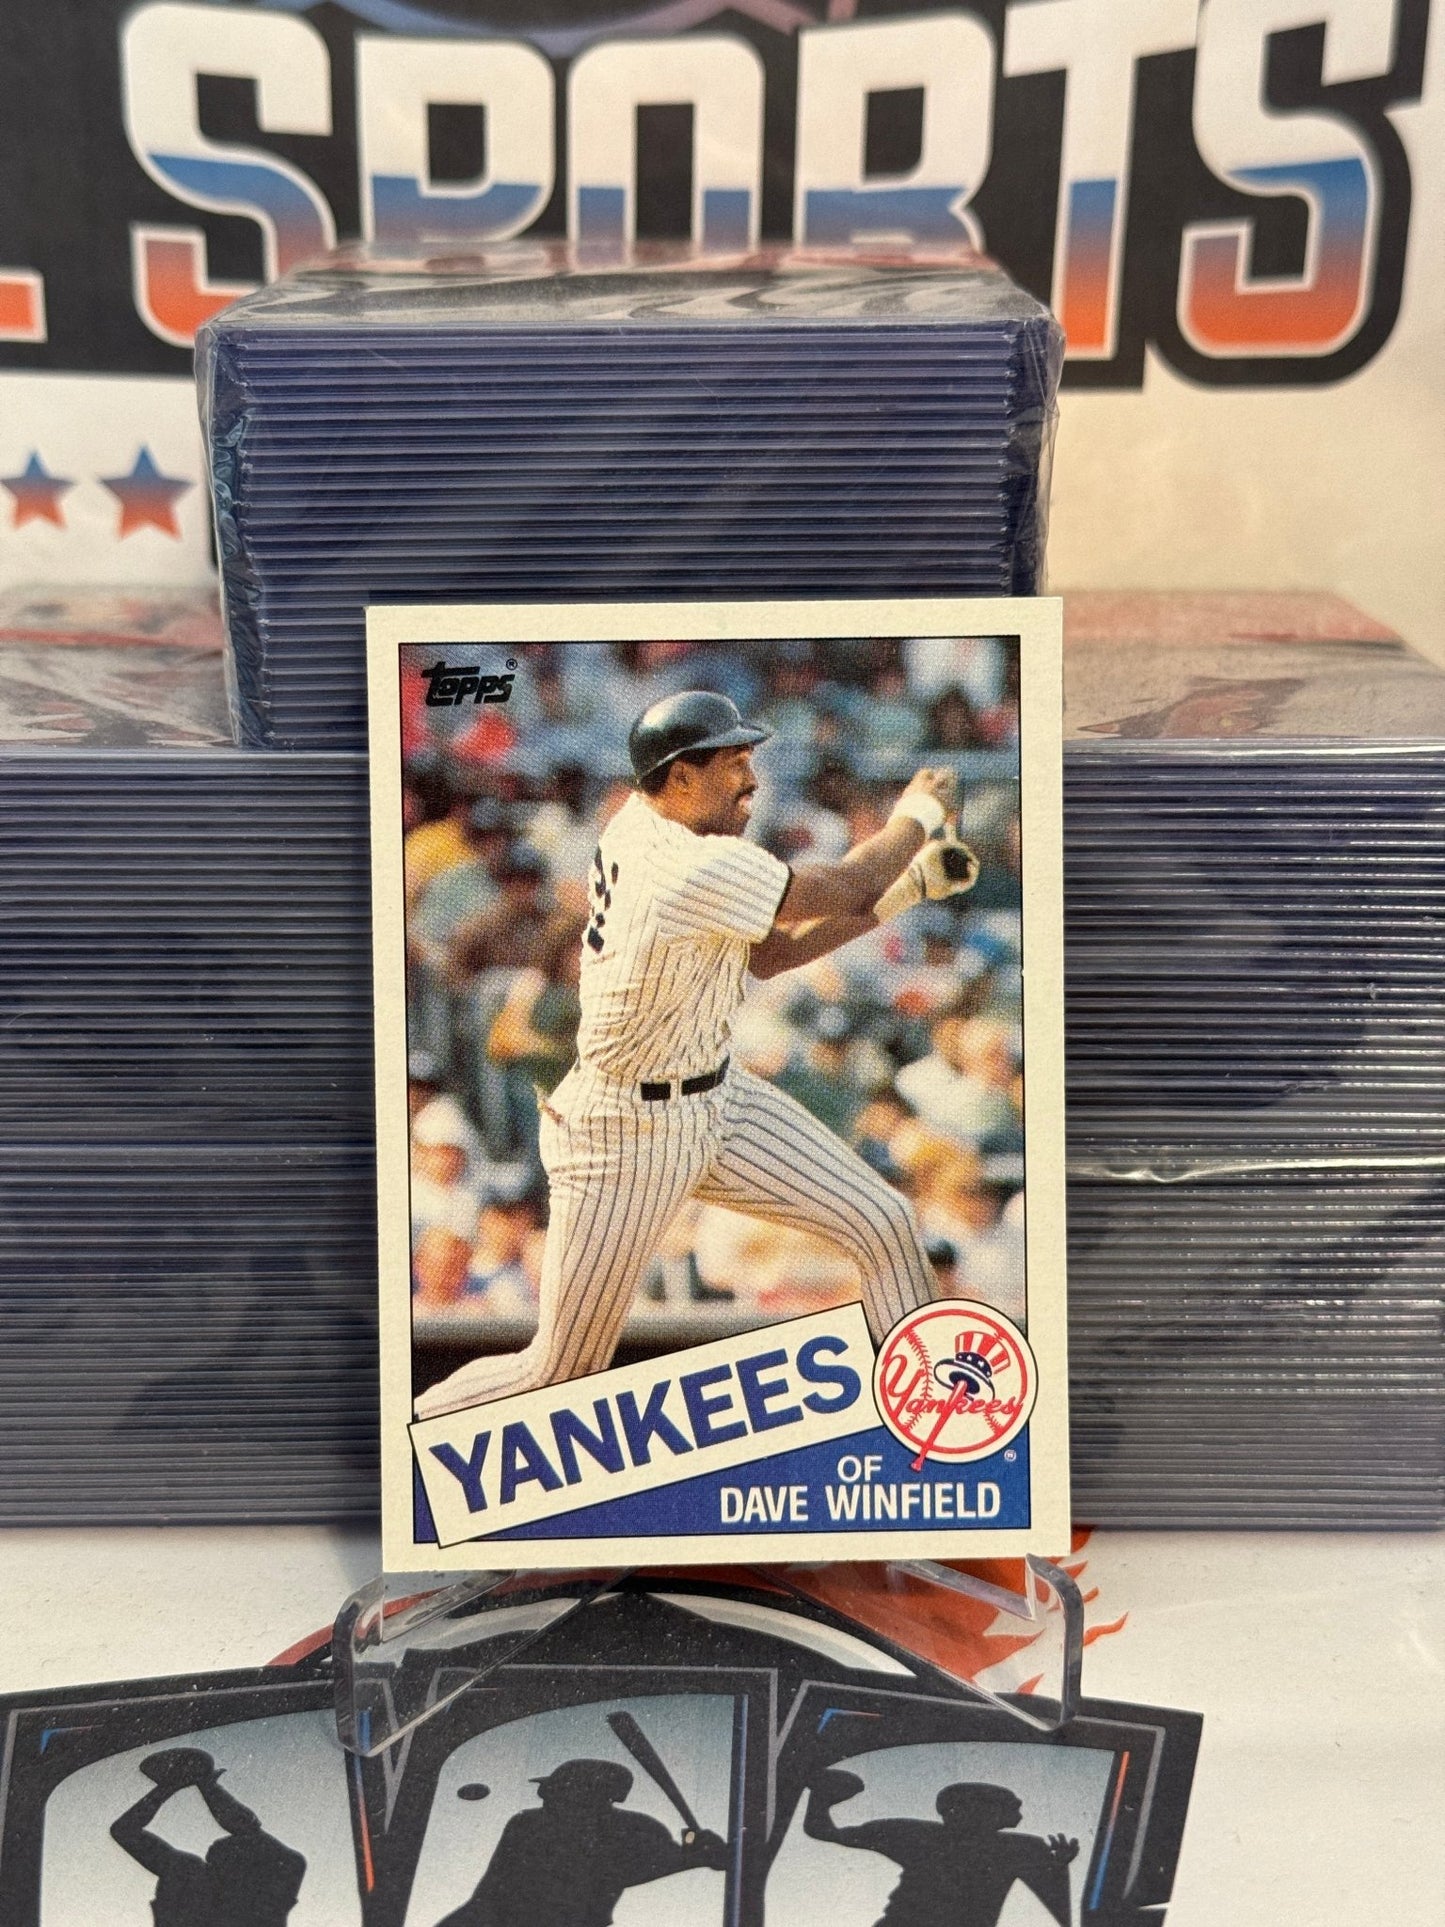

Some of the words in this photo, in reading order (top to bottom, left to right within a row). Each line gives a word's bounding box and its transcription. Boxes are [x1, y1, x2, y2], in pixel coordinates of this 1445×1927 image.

[122, 0, 1396, 360] SPORTS
[882, 1354, 1024, 1418] Yankees
[429, 1336, 862, 1513] YANKEES
[837, 1454, 883, 1482] OF
[720, 1485, 809, 1524] DAVE
[825, 1482, 1002, 1522] WINFIELD
